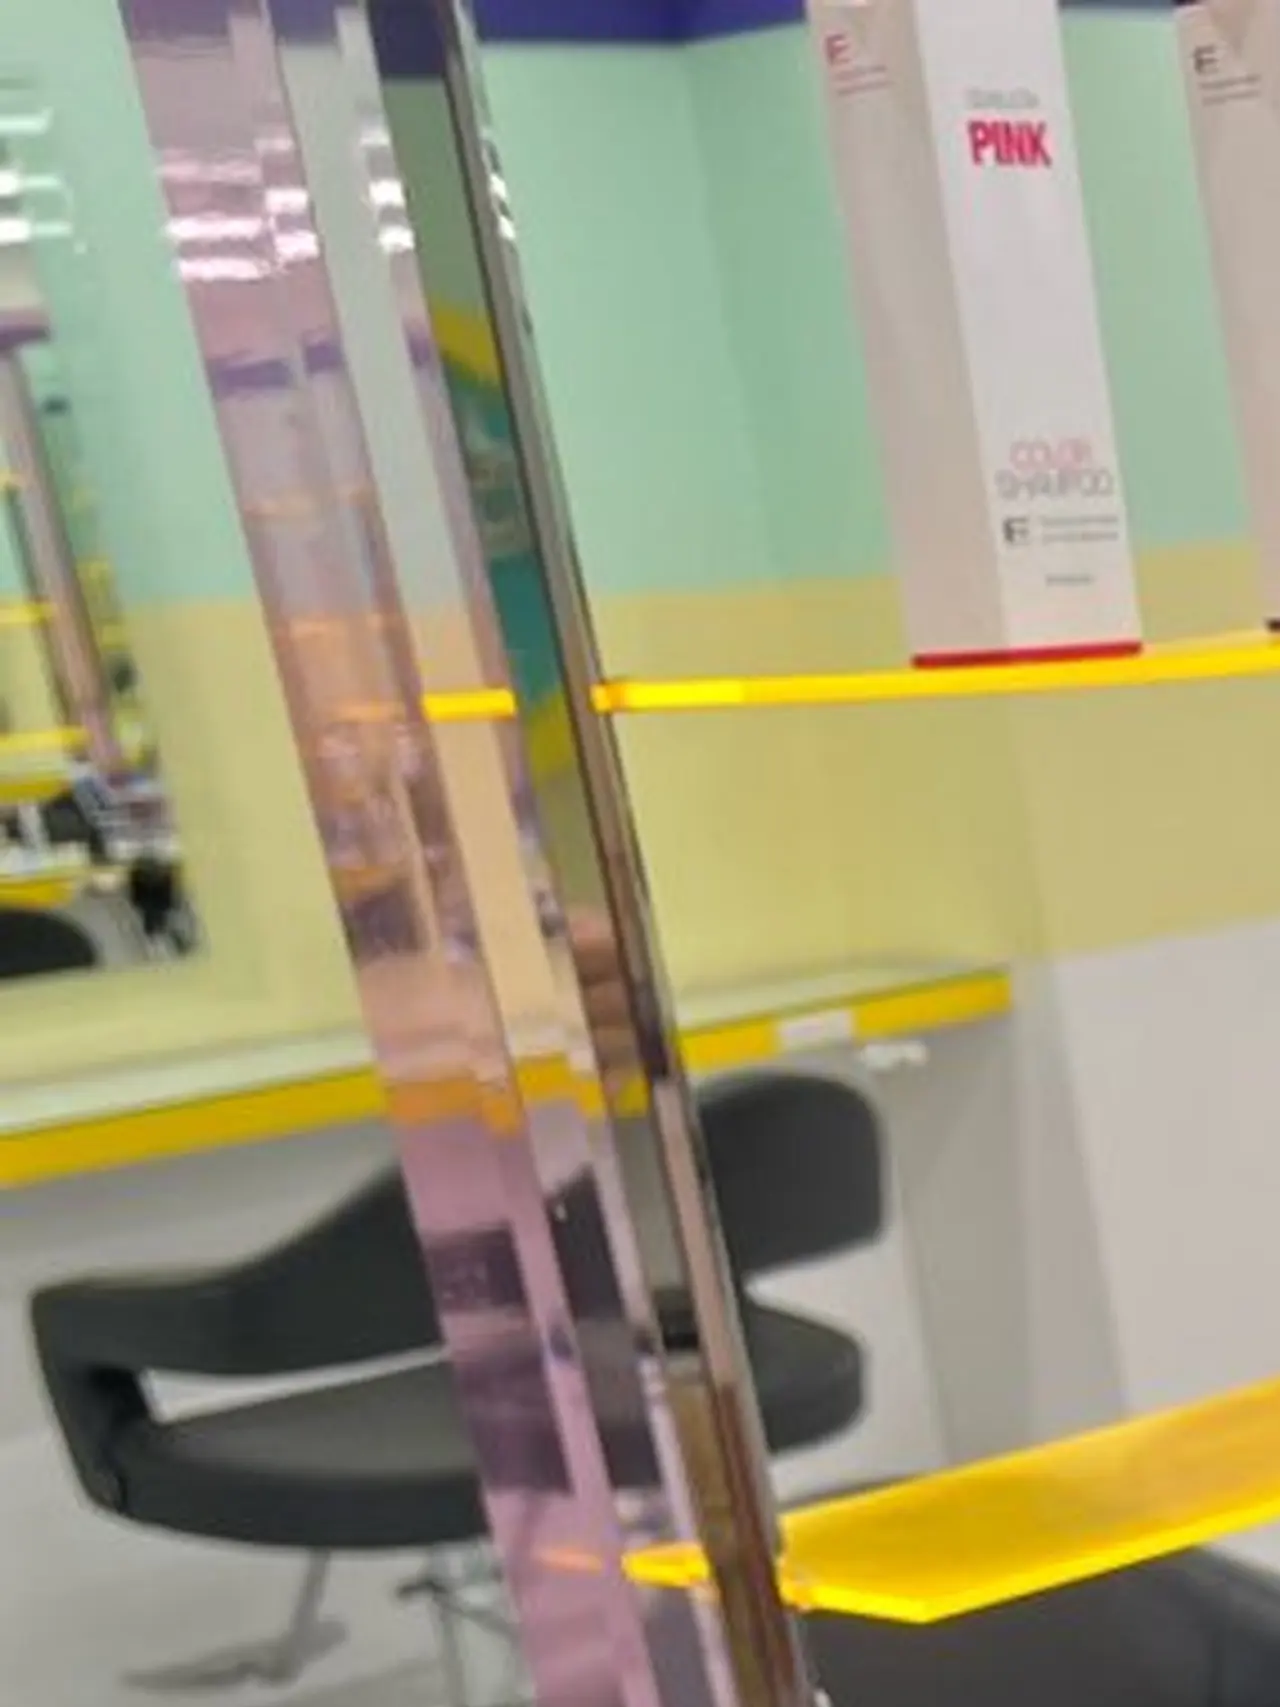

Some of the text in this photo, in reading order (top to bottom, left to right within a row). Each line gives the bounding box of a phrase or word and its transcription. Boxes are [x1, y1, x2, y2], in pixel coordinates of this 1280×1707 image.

[967, 120, 1052, 167] PINK
[1009, 437, 1093, 471] COLOR
[993, 468, 1115, 500] SHAMPOO
